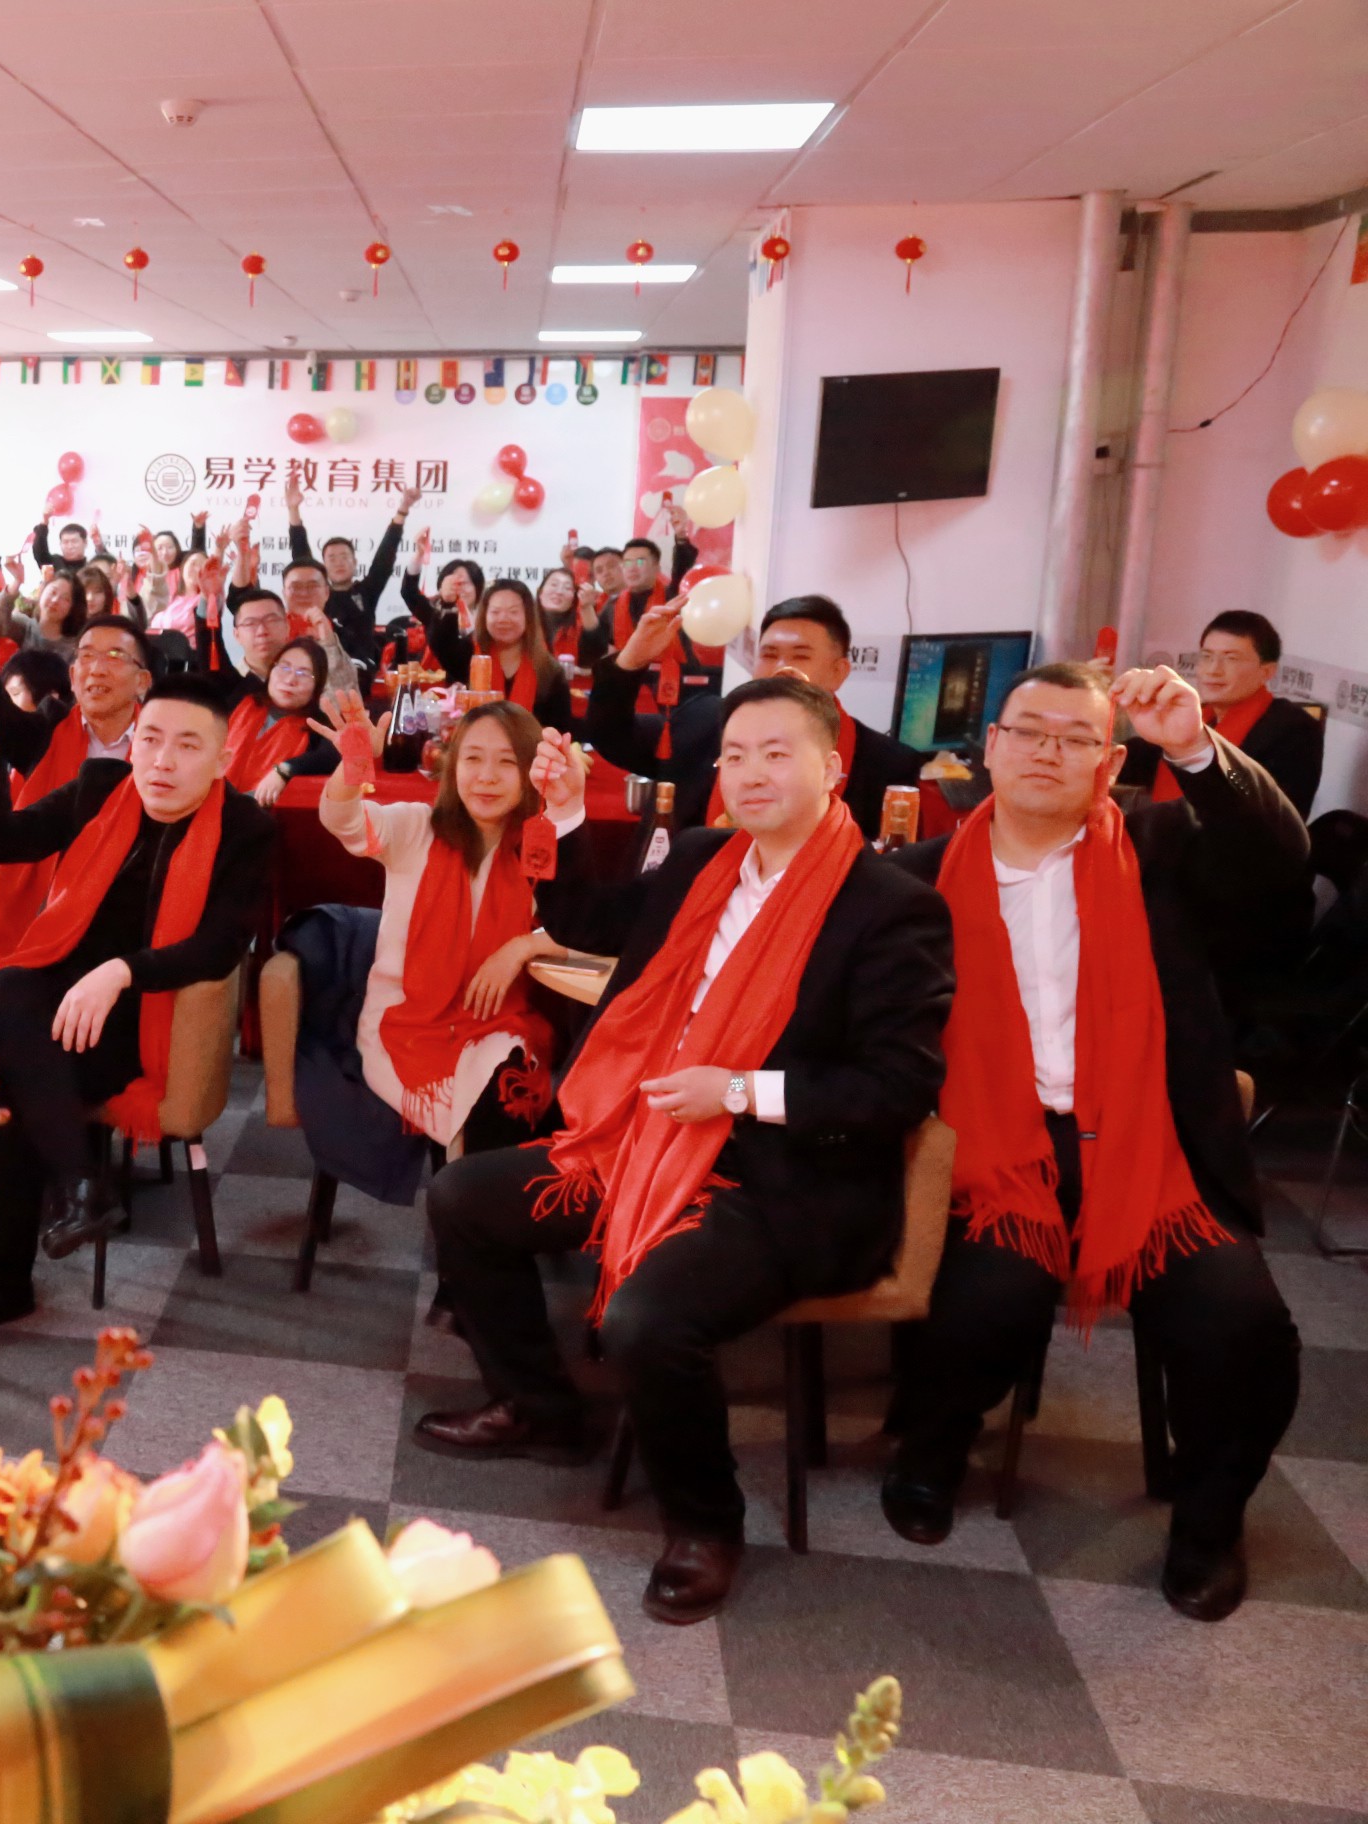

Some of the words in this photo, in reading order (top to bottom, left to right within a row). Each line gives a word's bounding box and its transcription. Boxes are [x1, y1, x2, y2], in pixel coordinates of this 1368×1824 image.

[204, 457, 449, 493] 易学教育集团
[206, 496, 246, 507] YIXU
[270, 496, 369, 509] ECATION
[386, 497, 445, 509] GUP
